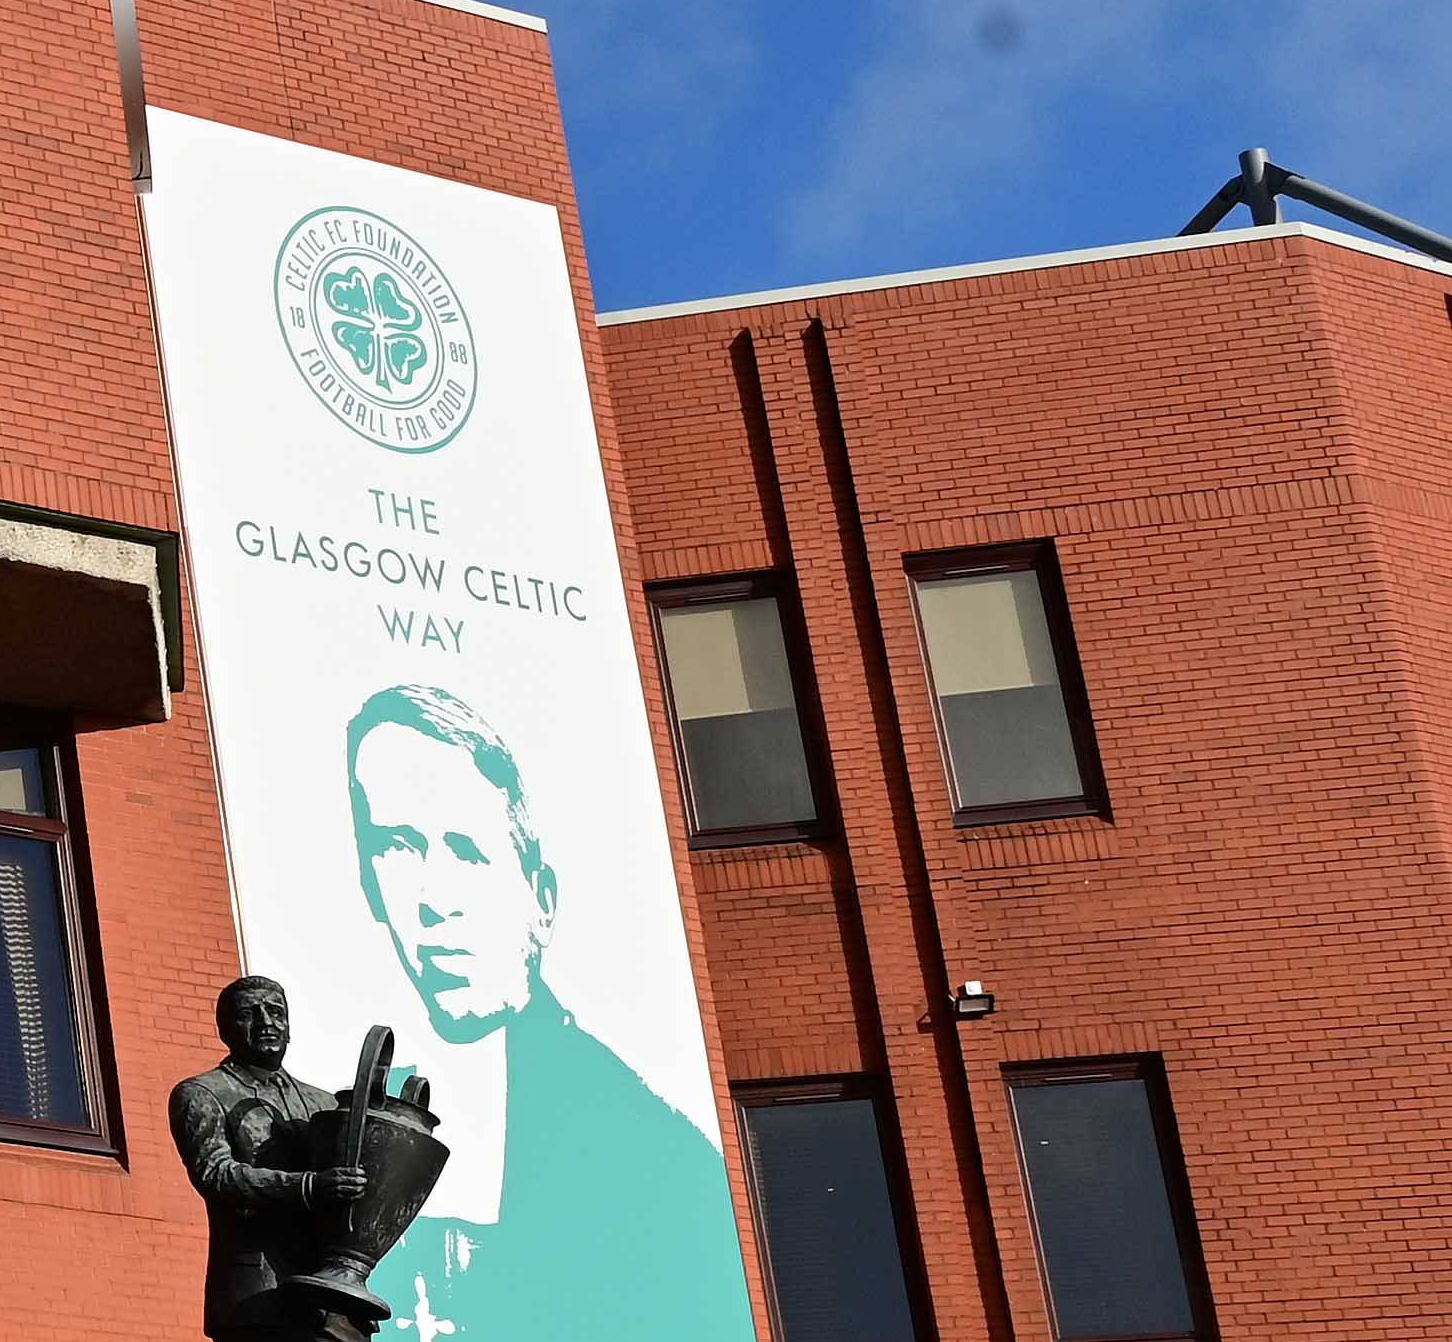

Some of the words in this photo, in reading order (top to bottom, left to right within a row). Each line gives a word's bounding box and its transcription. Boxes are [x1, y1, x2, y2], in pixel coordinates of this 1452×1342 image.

[285, 228, 326, 292] CELTIC
[324, 219, 348, 245] FC
[352, 219, 459, 324] FOUNDATION
[290, 305, 306, 329] 18
[449, 341, 468, 365] 88
[300, 348, 388, 437] FOOTBALL
[395, 415, 432, 441] FOR
[429, 378, 466, 430] GOOD
[367, 489, 441, 536] THE
[235, 520, 445, 594] GLASGOW
[464, 565, 588, 622] CELTIC
[377, 604, 465, 654] WAY
